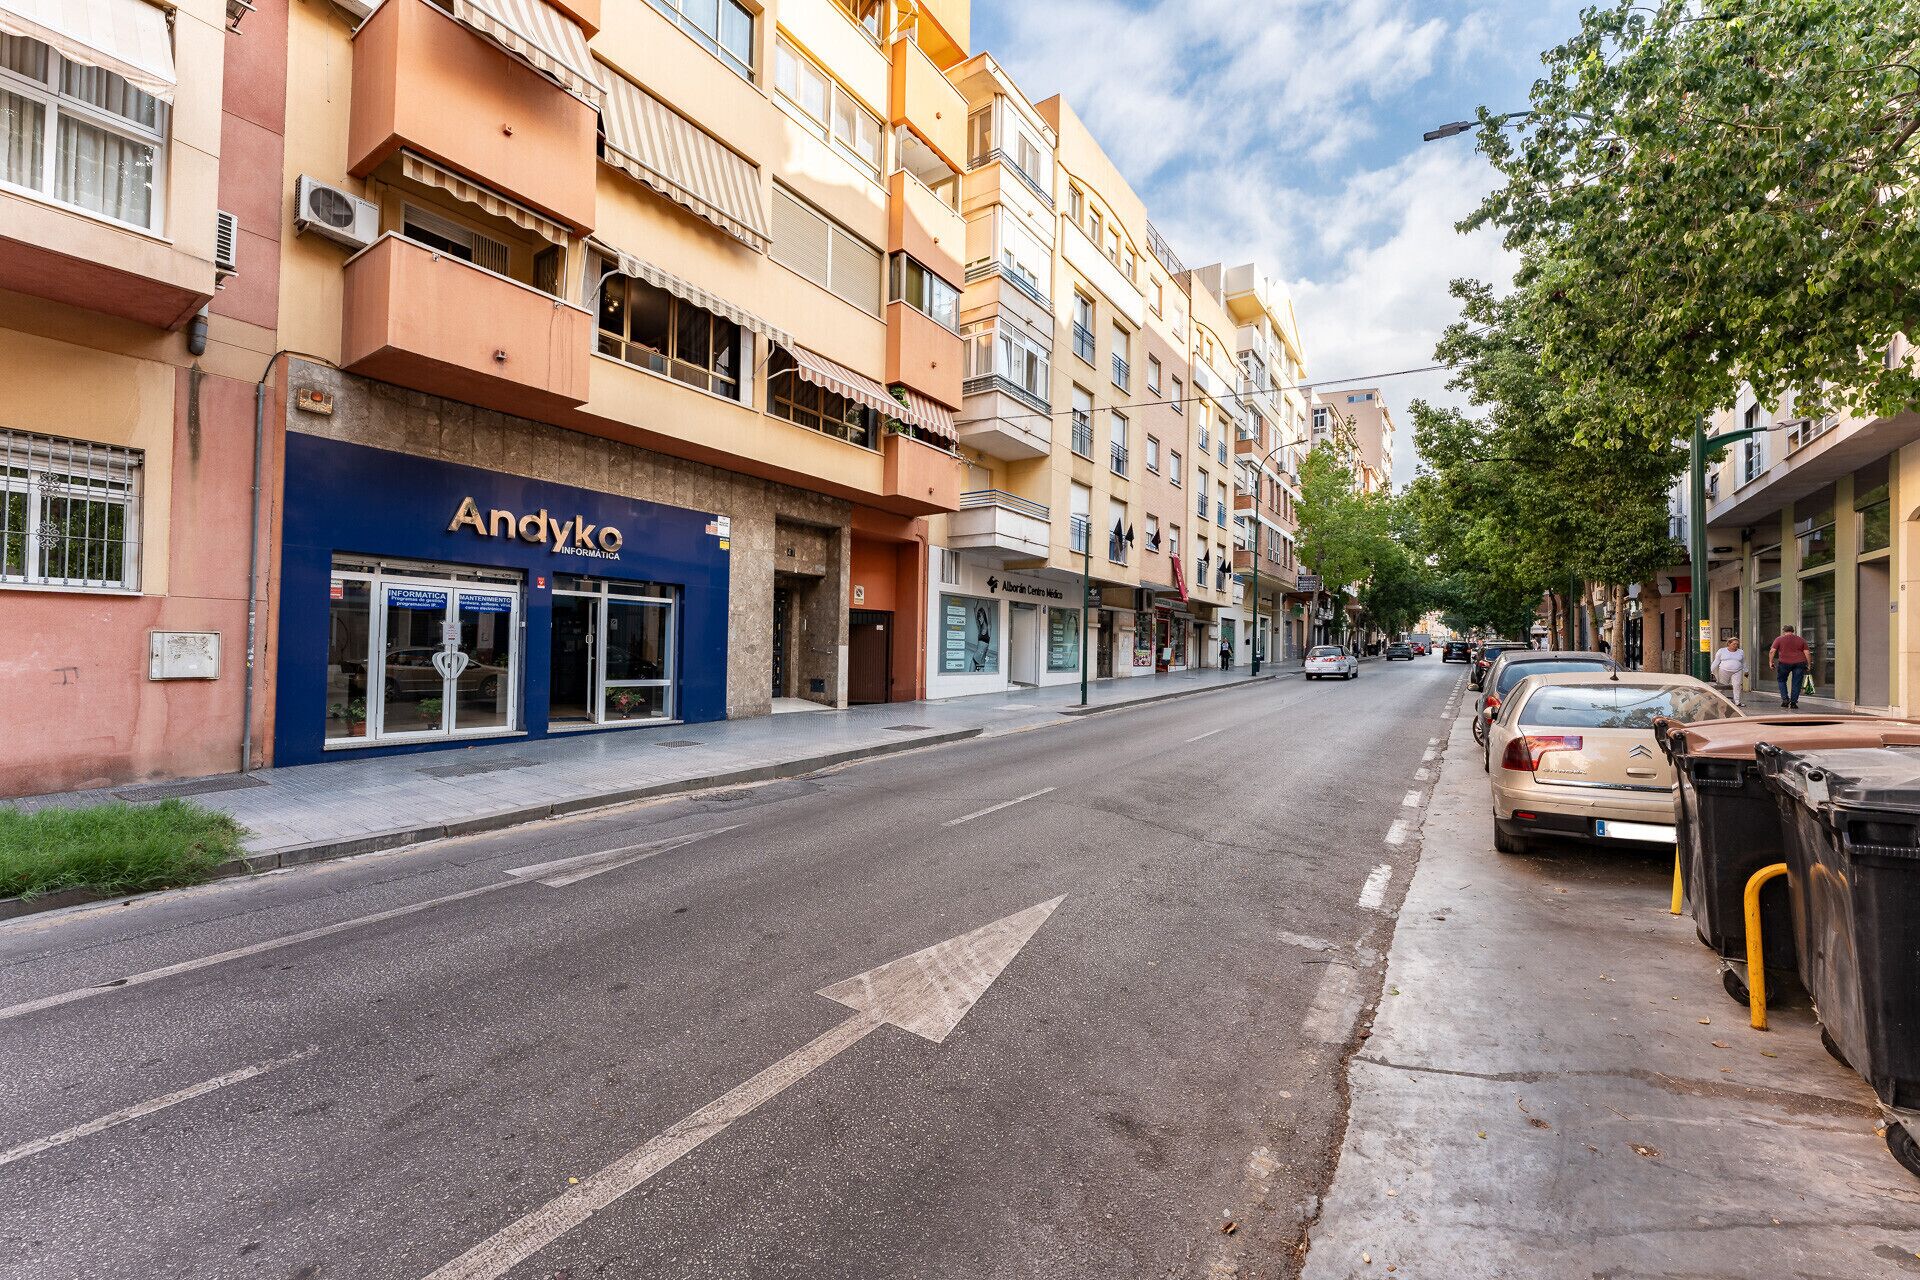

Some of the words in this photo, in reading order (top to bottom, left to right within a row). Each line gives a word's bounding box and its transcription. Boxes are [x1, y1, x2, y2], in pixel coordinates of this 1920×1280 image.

[447, 496, 623, 553] Andyko
[561, 546, 621, 561] INFORMÁTICA
[388, 590, 446, 600] INFORMATICA
[1027, 585, 1045, 597] Centro
[459, 595, 511, 603] MANTENIMIENTO
